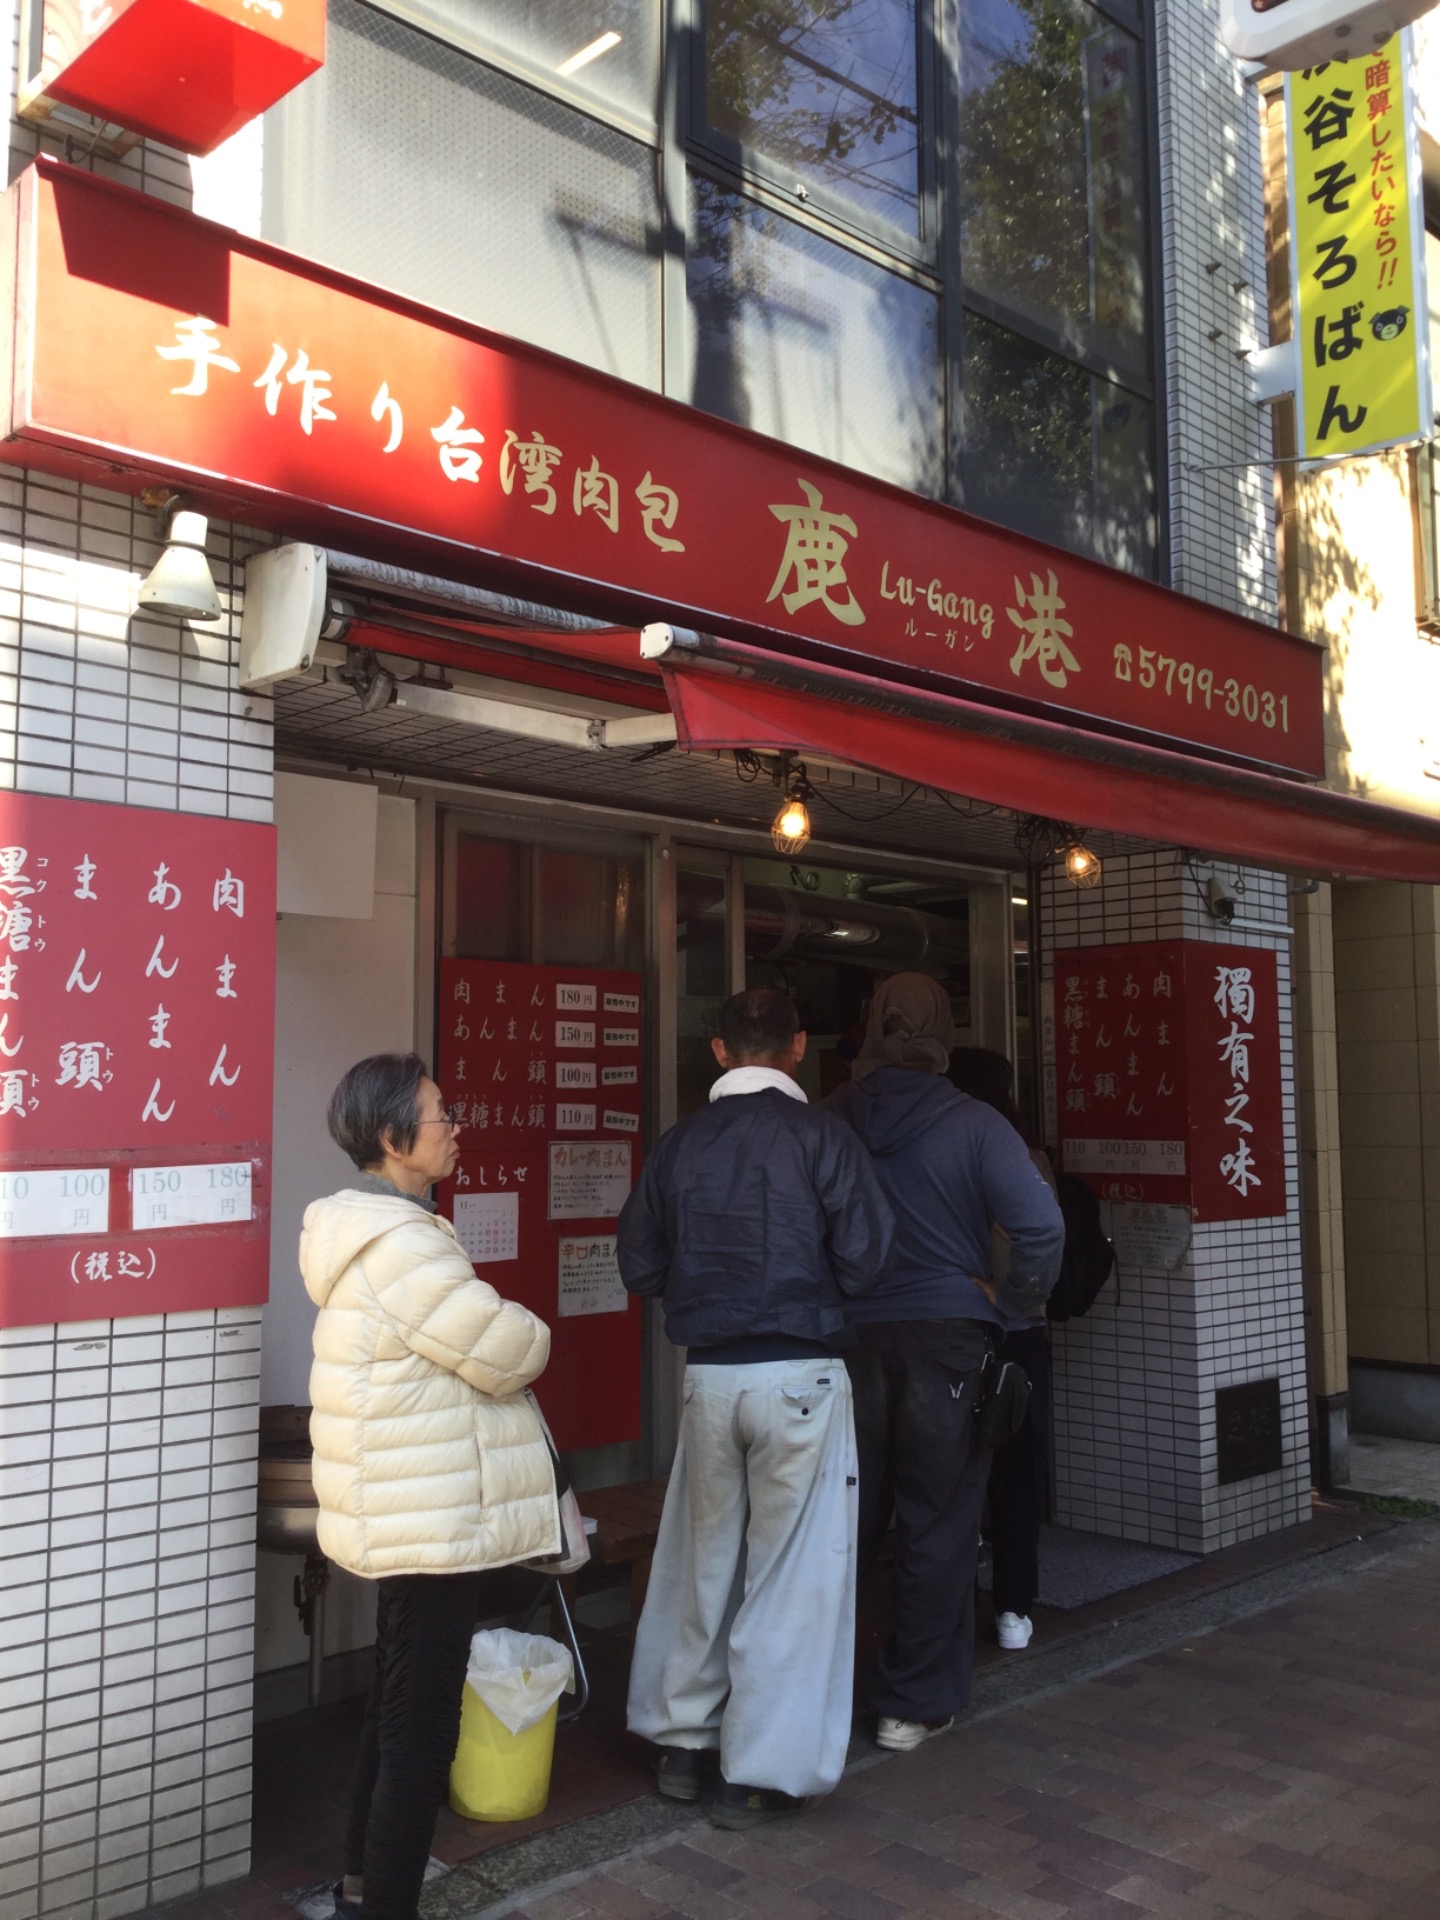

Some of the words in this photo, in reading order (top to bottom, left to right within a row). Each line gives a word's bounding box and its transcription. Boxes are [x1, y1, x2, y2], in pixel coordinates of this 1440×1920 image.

[1364, 50, 1399, 290] 暗算したいなら!!
[1302, 58, 1367, 440] 谷そろばん
[155, 314, 686, 552] 手作り台湾肉包
[765, 479, 866, 626] 鹿
[880, 560, 995, 639] Lu-Gang
[1006, 567, 1082, 689] 港
[904, 619, 976, 653] ルーガン
[1138, 645, 1290, 734] 5799-3031
[55, 853, 105, 1091] まん頭
[142, 861, 182, 1123] あんまん
[209, 868, 245, 1088] 肉まん
[454, 977, 545, 1007] 肉まん
[454, 1013, 545, 1042] あんまん
[1152, 969, 1175, 1097] 肉まん
[455, 1056, 547, 1086] まん頭
[1063, 976, 1087, 1113] 黒糖まん頭
[1094, 974, 1117, 1100] まん頭
[1122, 972, 1144, 1117] あんまん
[1213, 965, 1262, 1198] 獨有之味
[59, 1174, 105, 1198] 100
[138, 1170, 181, 1195] 150
[206, 1166, 248, 1189] 180
[455, 1164, 528, 1186] おしらせ
[553, 1146, 628, 1169] カレー肉まん
[70, 1247, 156, 1284] (税込)
